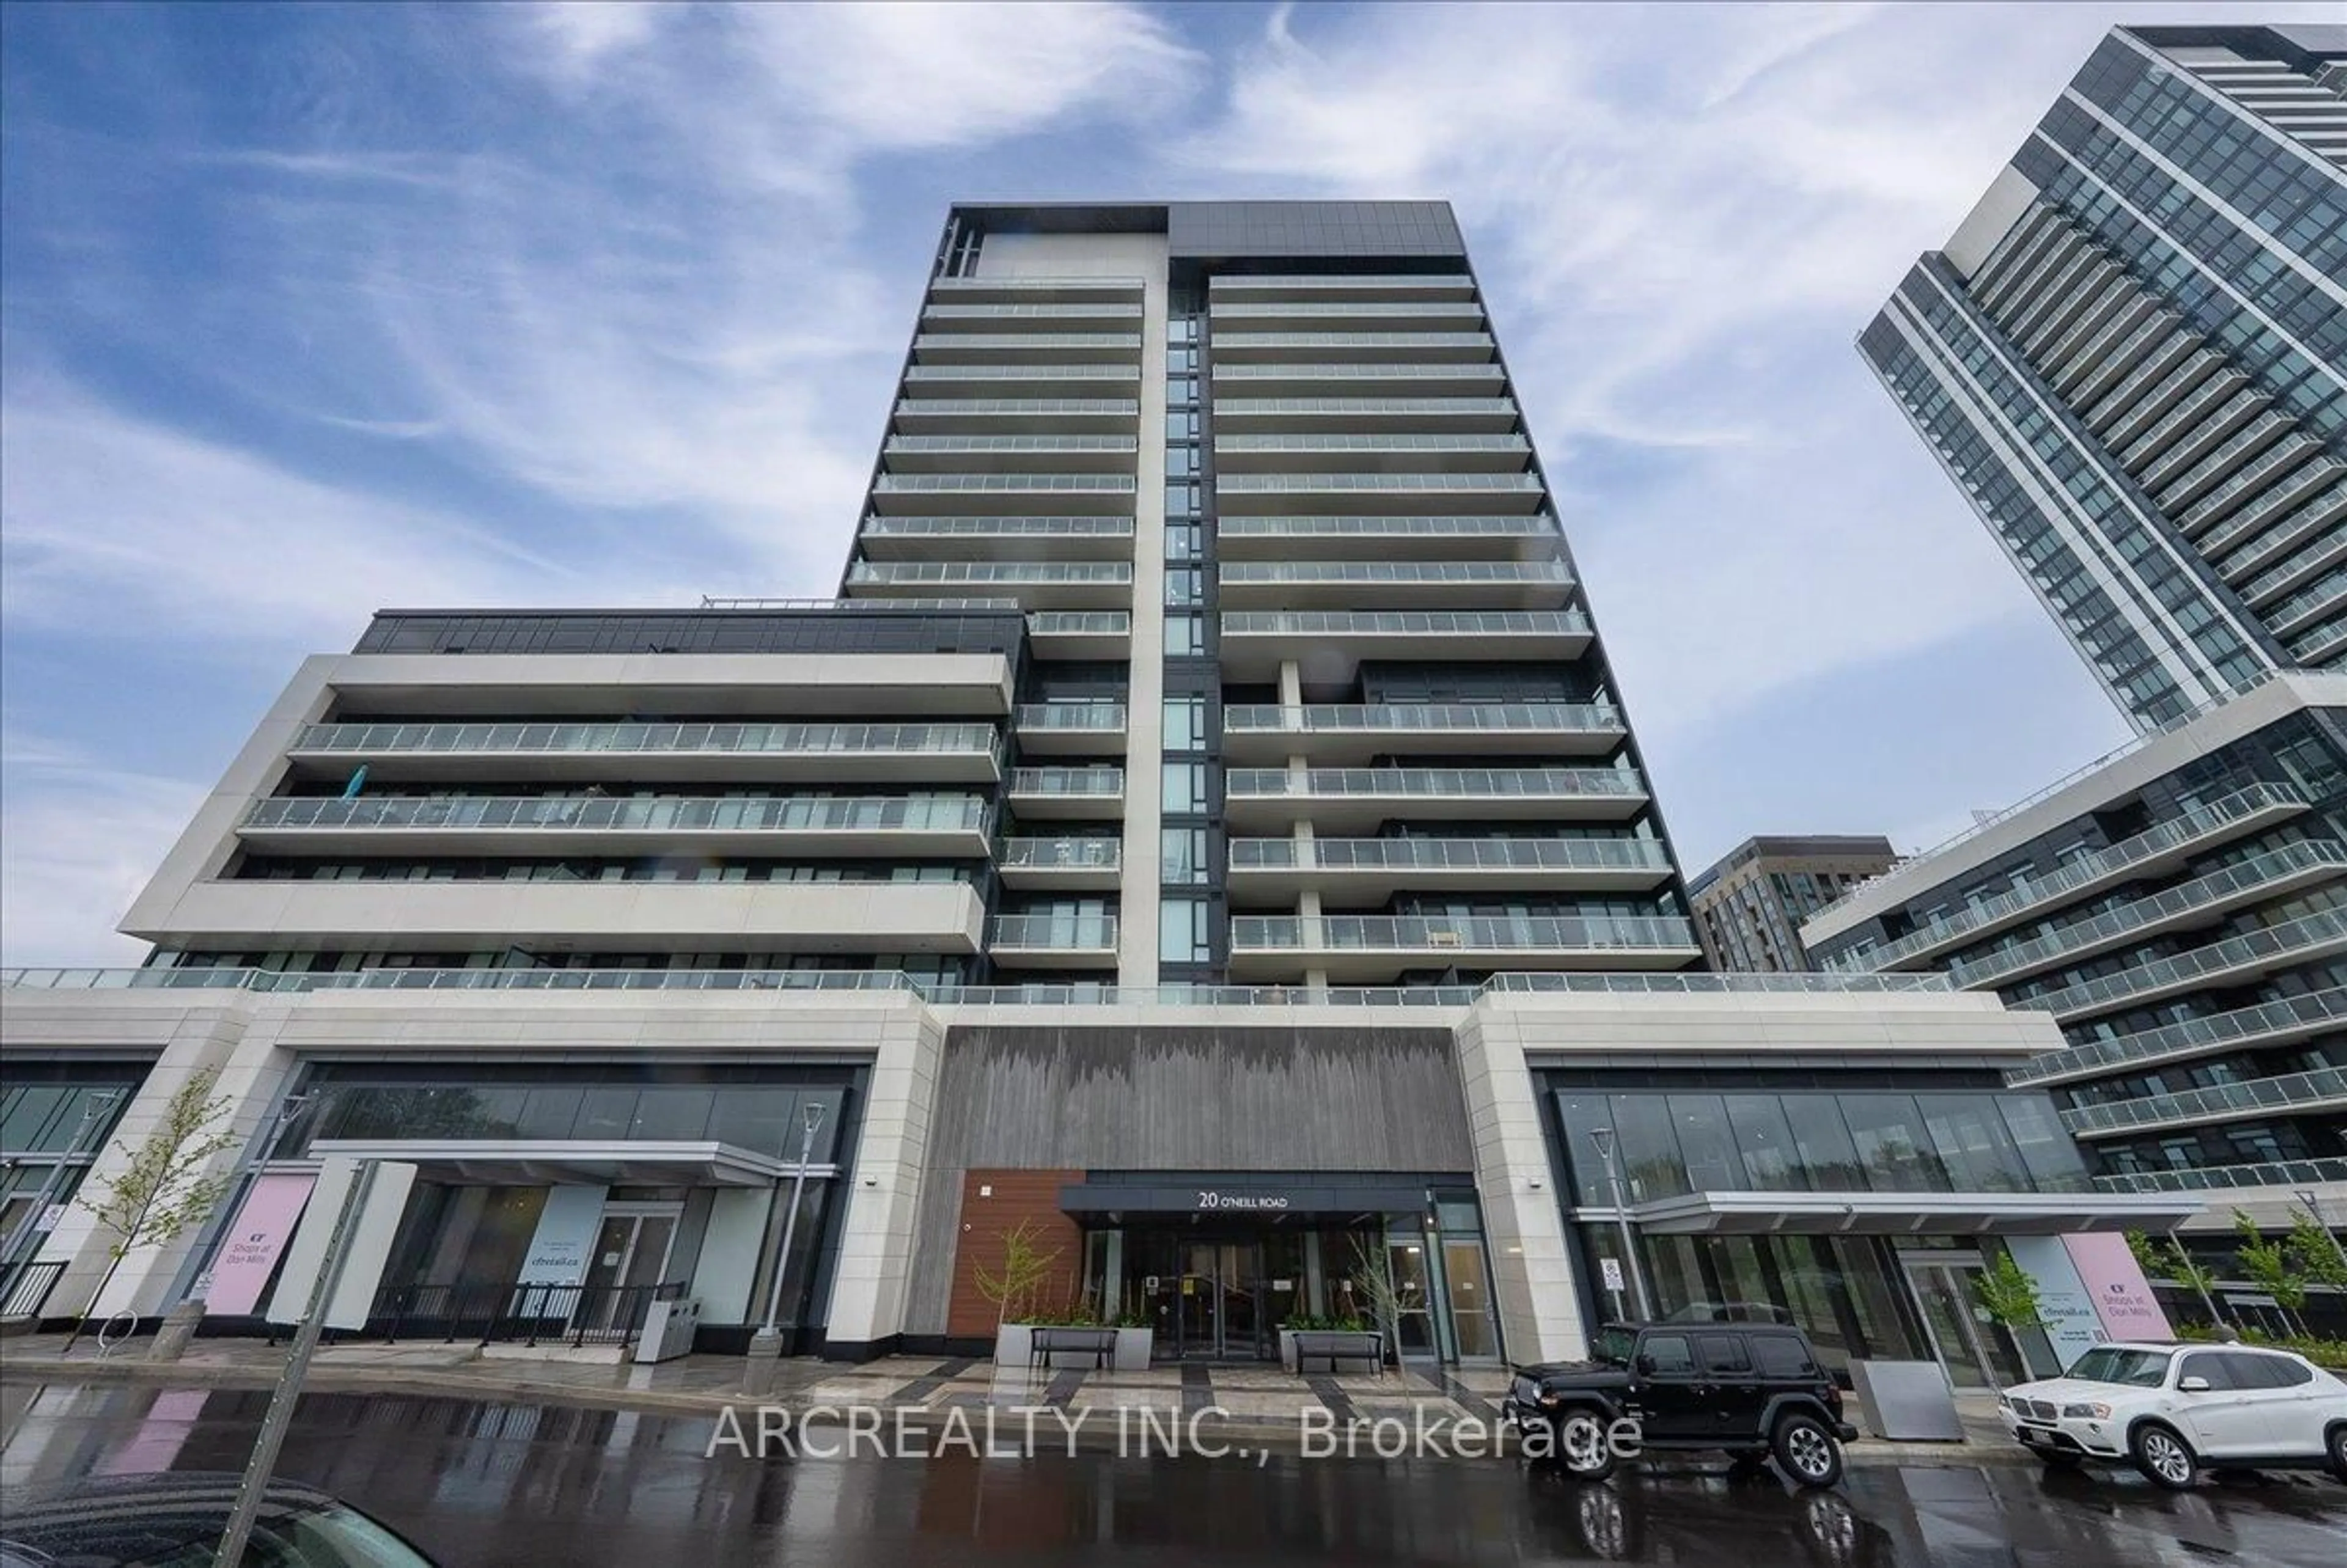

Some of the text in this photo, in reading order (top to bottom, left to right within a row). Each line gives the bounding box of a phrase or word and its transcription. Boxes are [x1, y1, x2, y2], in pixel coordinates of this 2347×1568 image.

[1199, 1192, 1288, 1207] 20 O'NEILL ROAD
